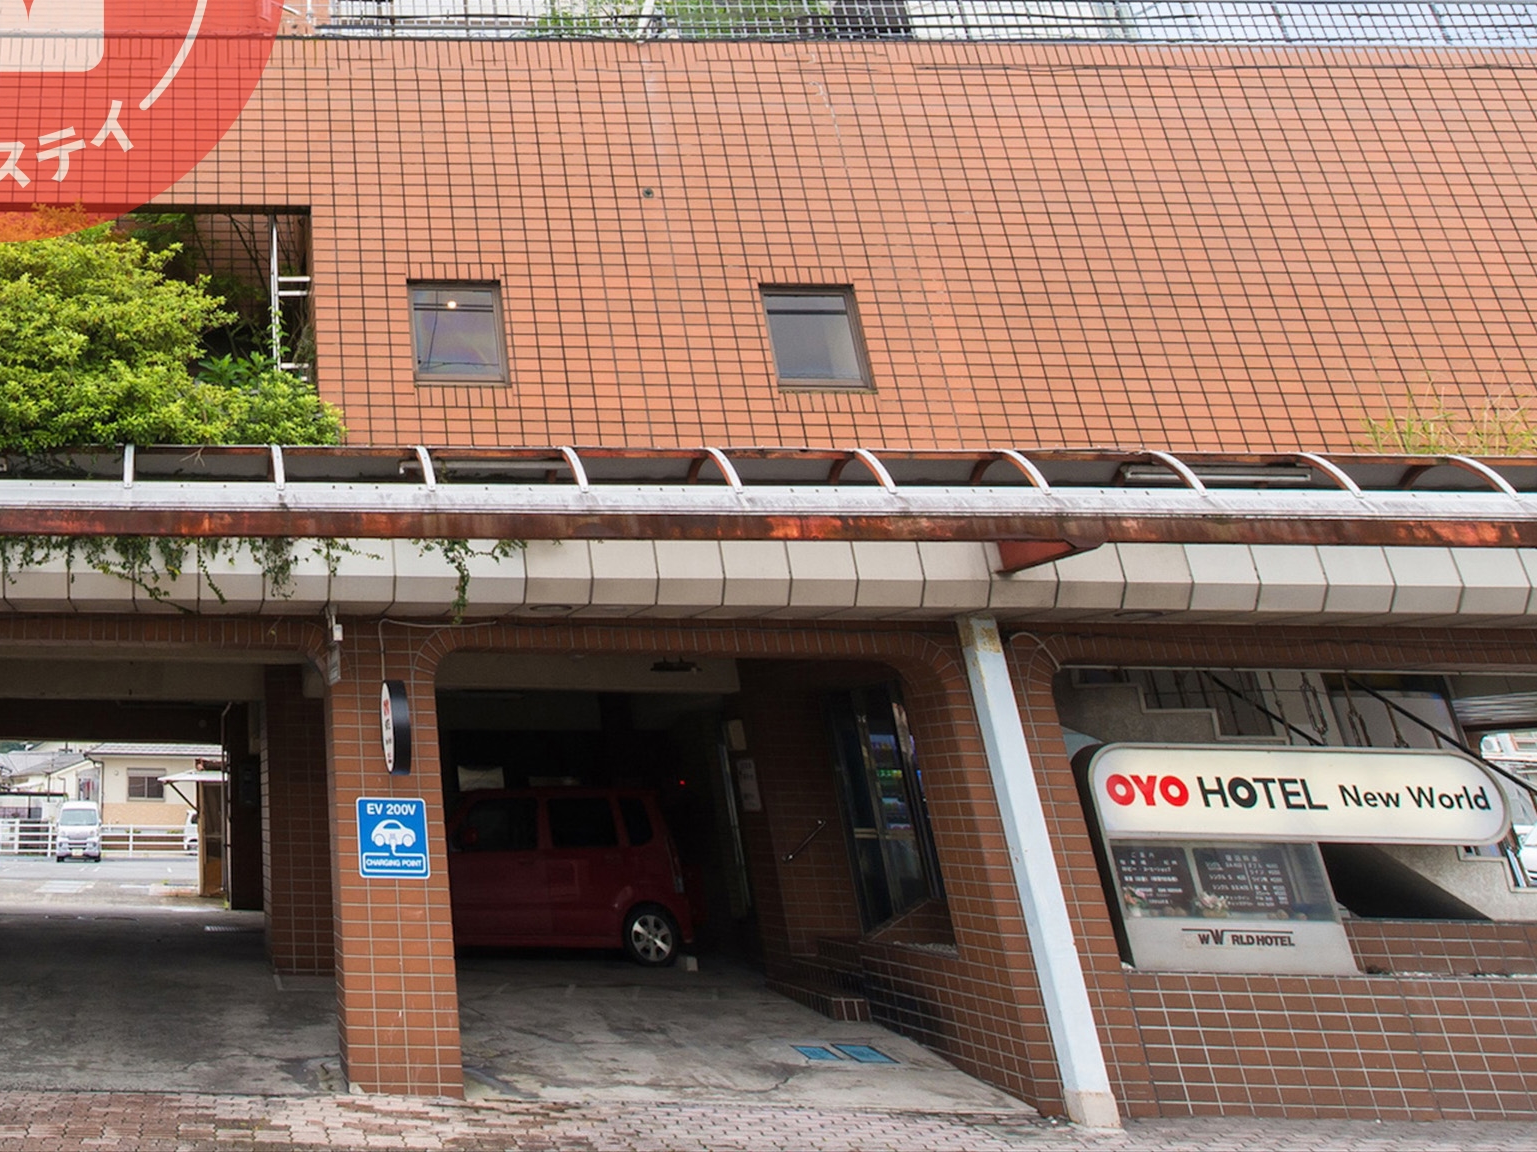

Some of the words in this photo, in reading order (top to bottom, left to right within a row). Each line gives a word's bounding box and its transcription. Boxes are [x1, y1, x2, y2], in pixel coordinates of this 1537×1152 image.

[1106, 773, 1189, 807] OYO
[1196, 776, 1329, 810] HOTEL
[1338, 785, 1400, 808] New
[1406, 785, 1491, 810] World
[366, 803, 383, 815] EV
[386, 803, 416, 816] 200V
[366, 858, 400, 867] CHARGING
[402, 859, 422, 867] POINT
[1256, 935, 1295, 947] HOTEL
